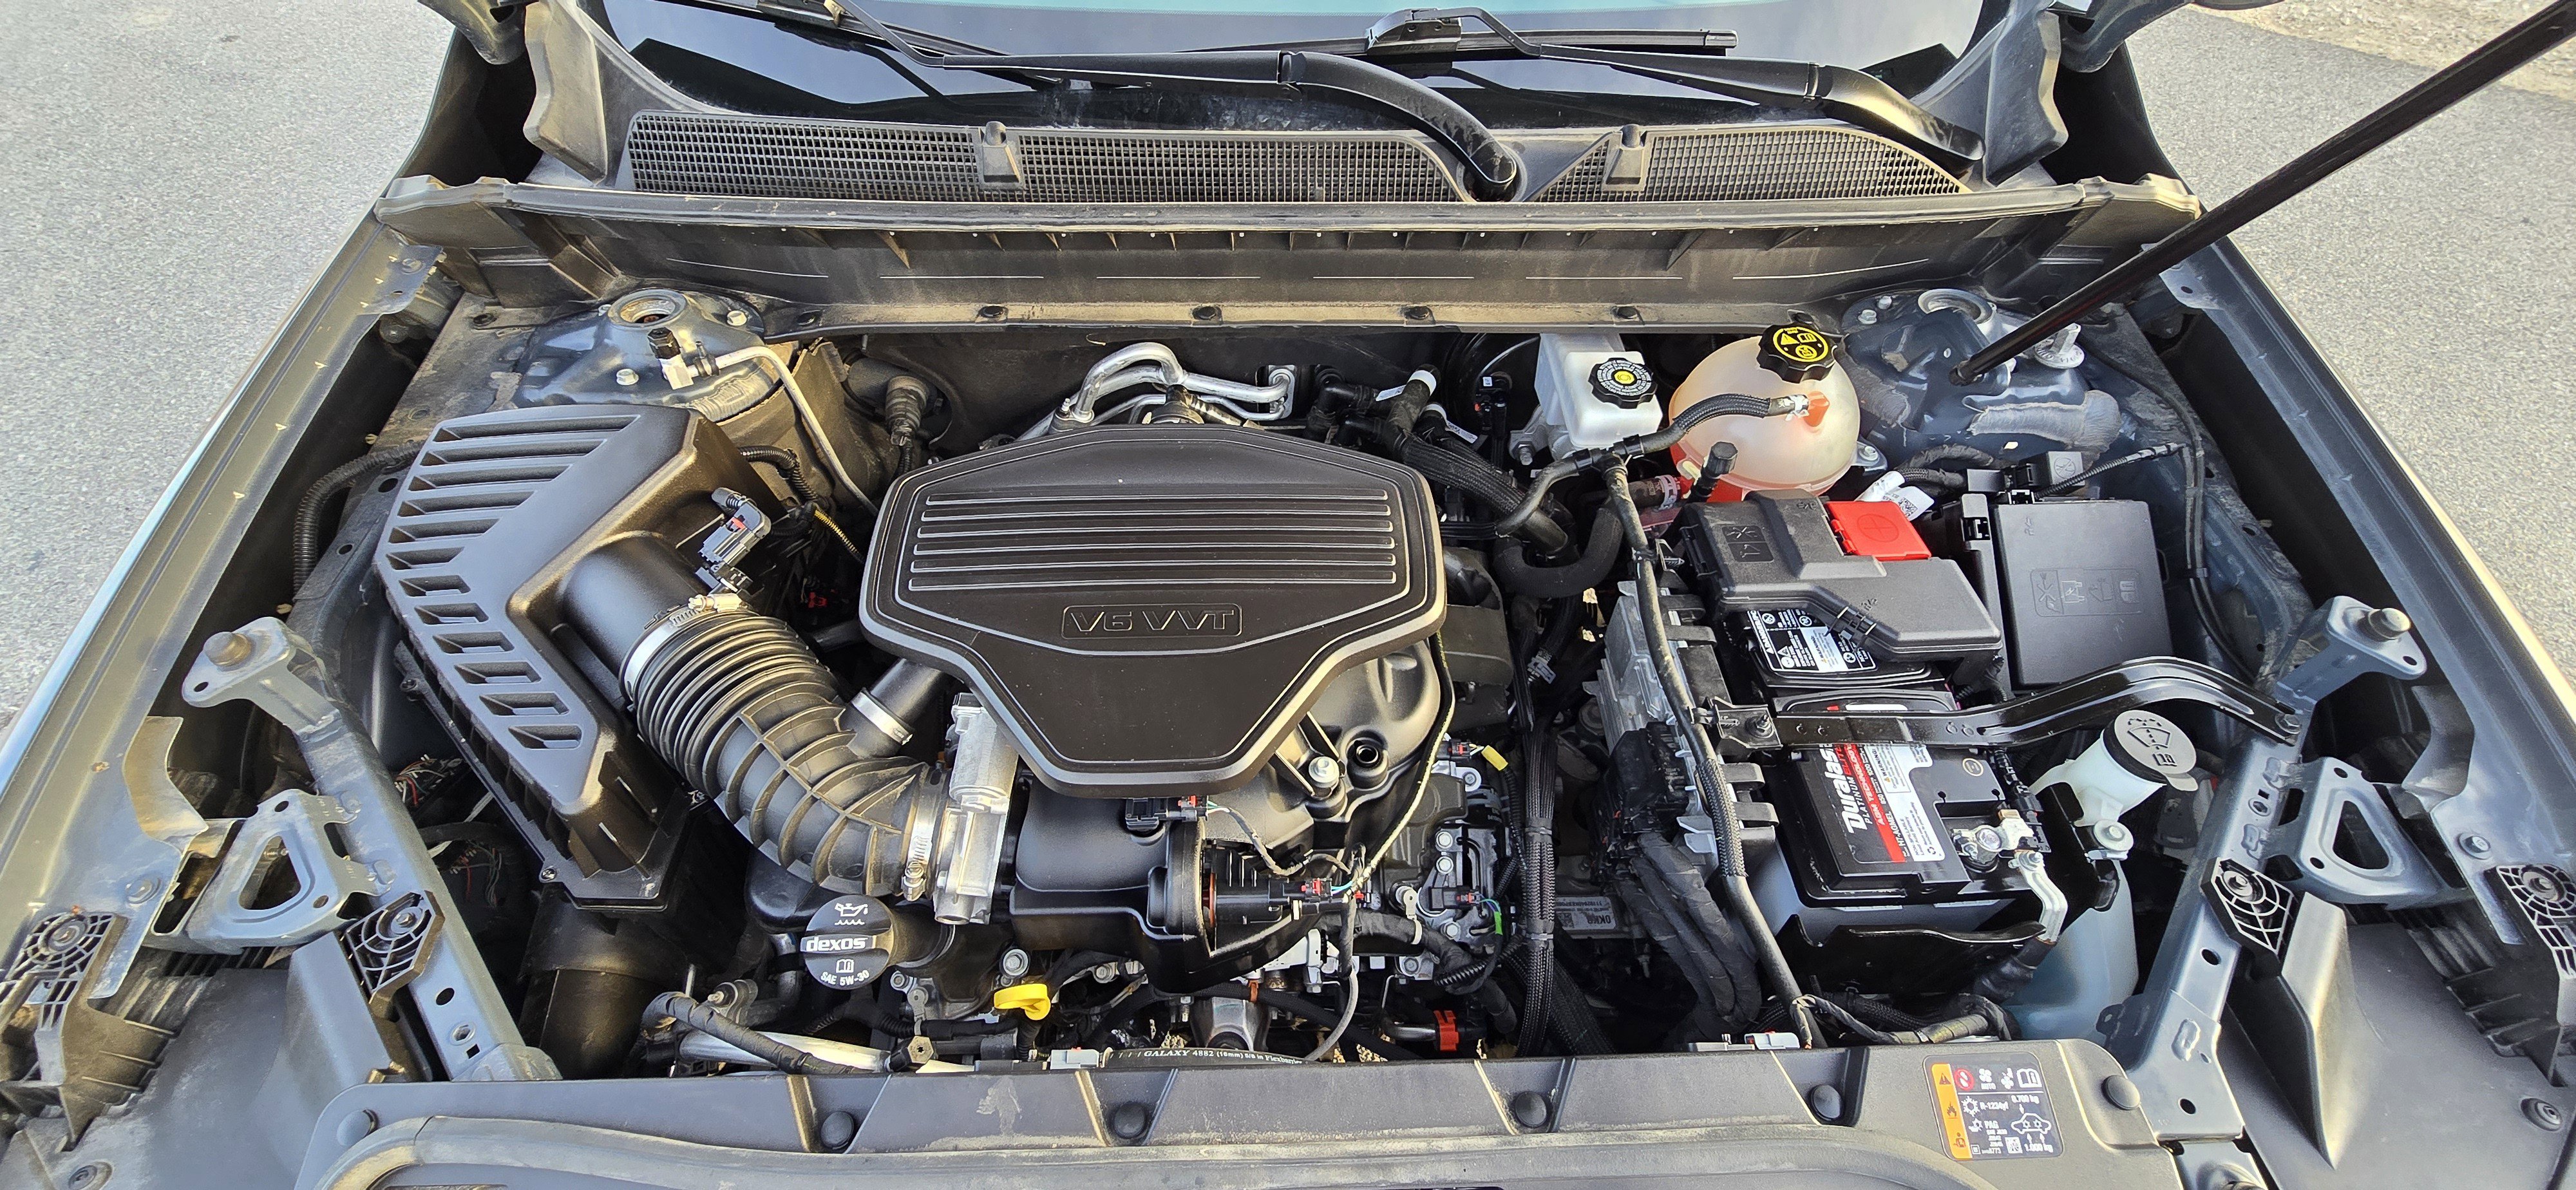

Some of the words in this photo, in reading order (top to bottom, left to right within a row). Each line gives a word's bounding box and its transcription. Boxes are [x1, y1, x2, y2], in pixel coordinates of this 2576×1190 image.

[1071, 611, 1132, 632] V6
[1142, 609, 1234, 630] VVT
[1872, 748, 1888, 777] WARNING:
[1819, 748, 1868, 834] Duralas
[1846, 776, 1873, 824] PLATINUM
[1871, 804, 1886, 826] AGM
[1900, 818, 1919, 855] NON-SPILLABLE
[806, 936, 868, 951] dexos
[820, 971, 837, 985] SAE
[839, 970, 869, 986] 5W-30
[1984, 1120, 1999, 1129] PAG
